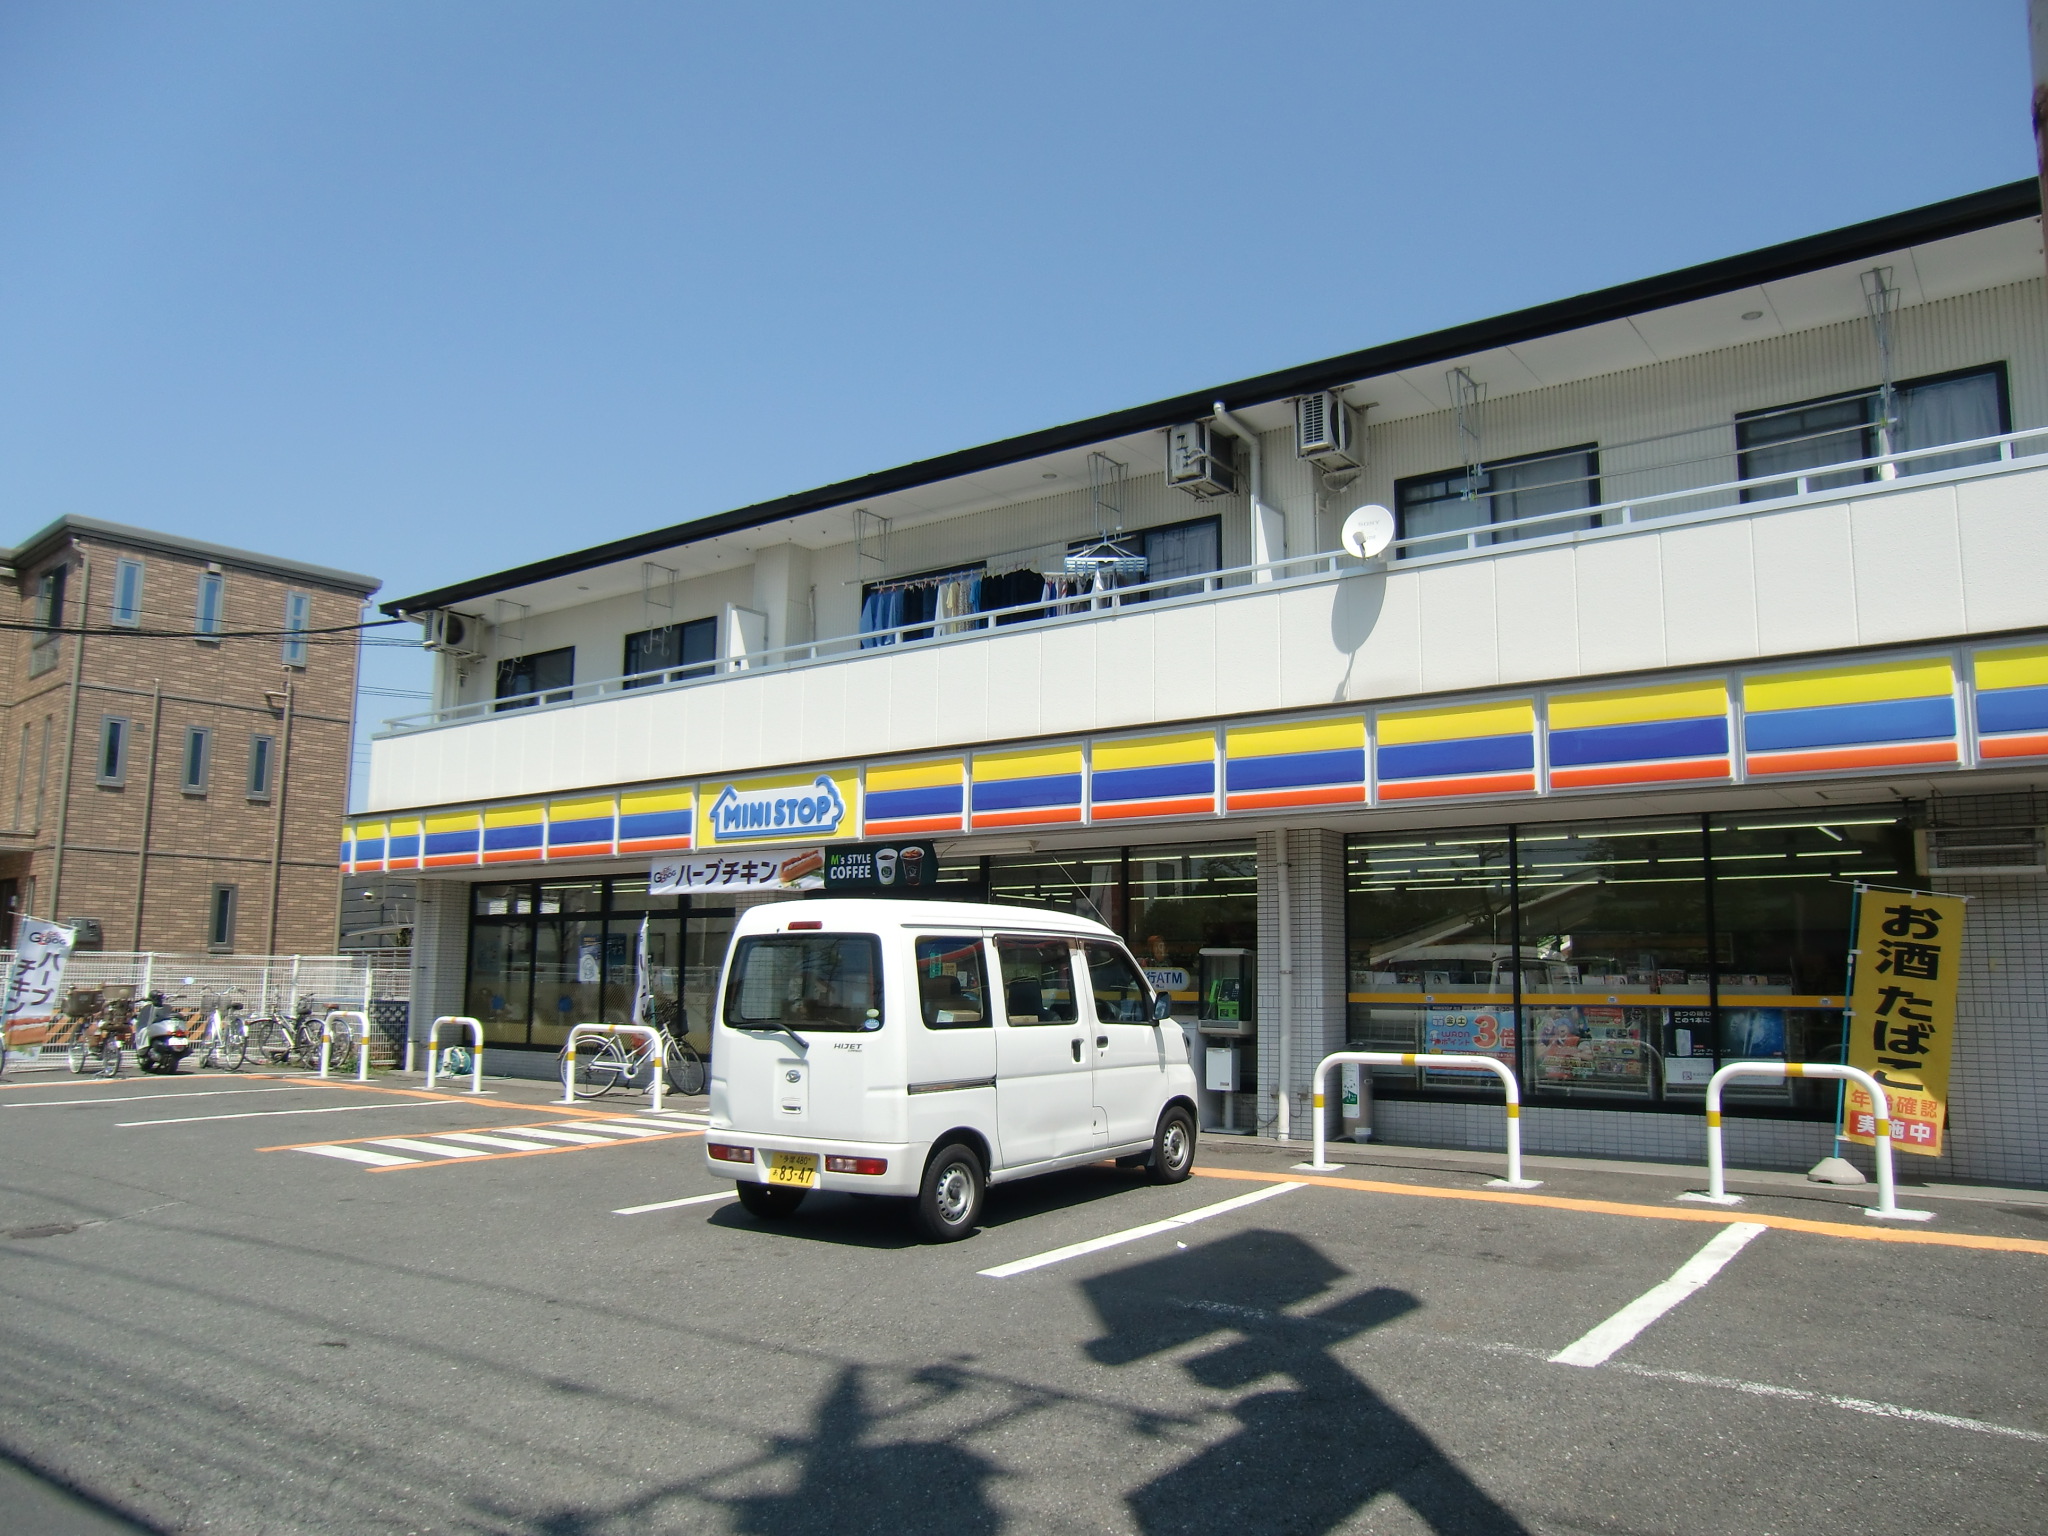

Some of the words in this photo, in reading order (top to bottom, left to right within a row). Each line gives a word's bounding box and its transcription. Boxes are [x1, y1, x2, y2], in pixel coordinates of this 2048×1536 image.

[723, 795, 832, 830] MINISTOP
[675, 858, 778, 888] ハーブチキン
[830, 865, 871, 880] COFFEE
[847, 853, 871, 864] STYLE
[1875, 905, 1943, 980] お酒
[4, 959, 37, 1015] チキン
[30, 952, 61, 1006] ハーブ
[1873, 985, 1937, 1092] たばこ
[779, 1165, 814, 1184] 83-47
